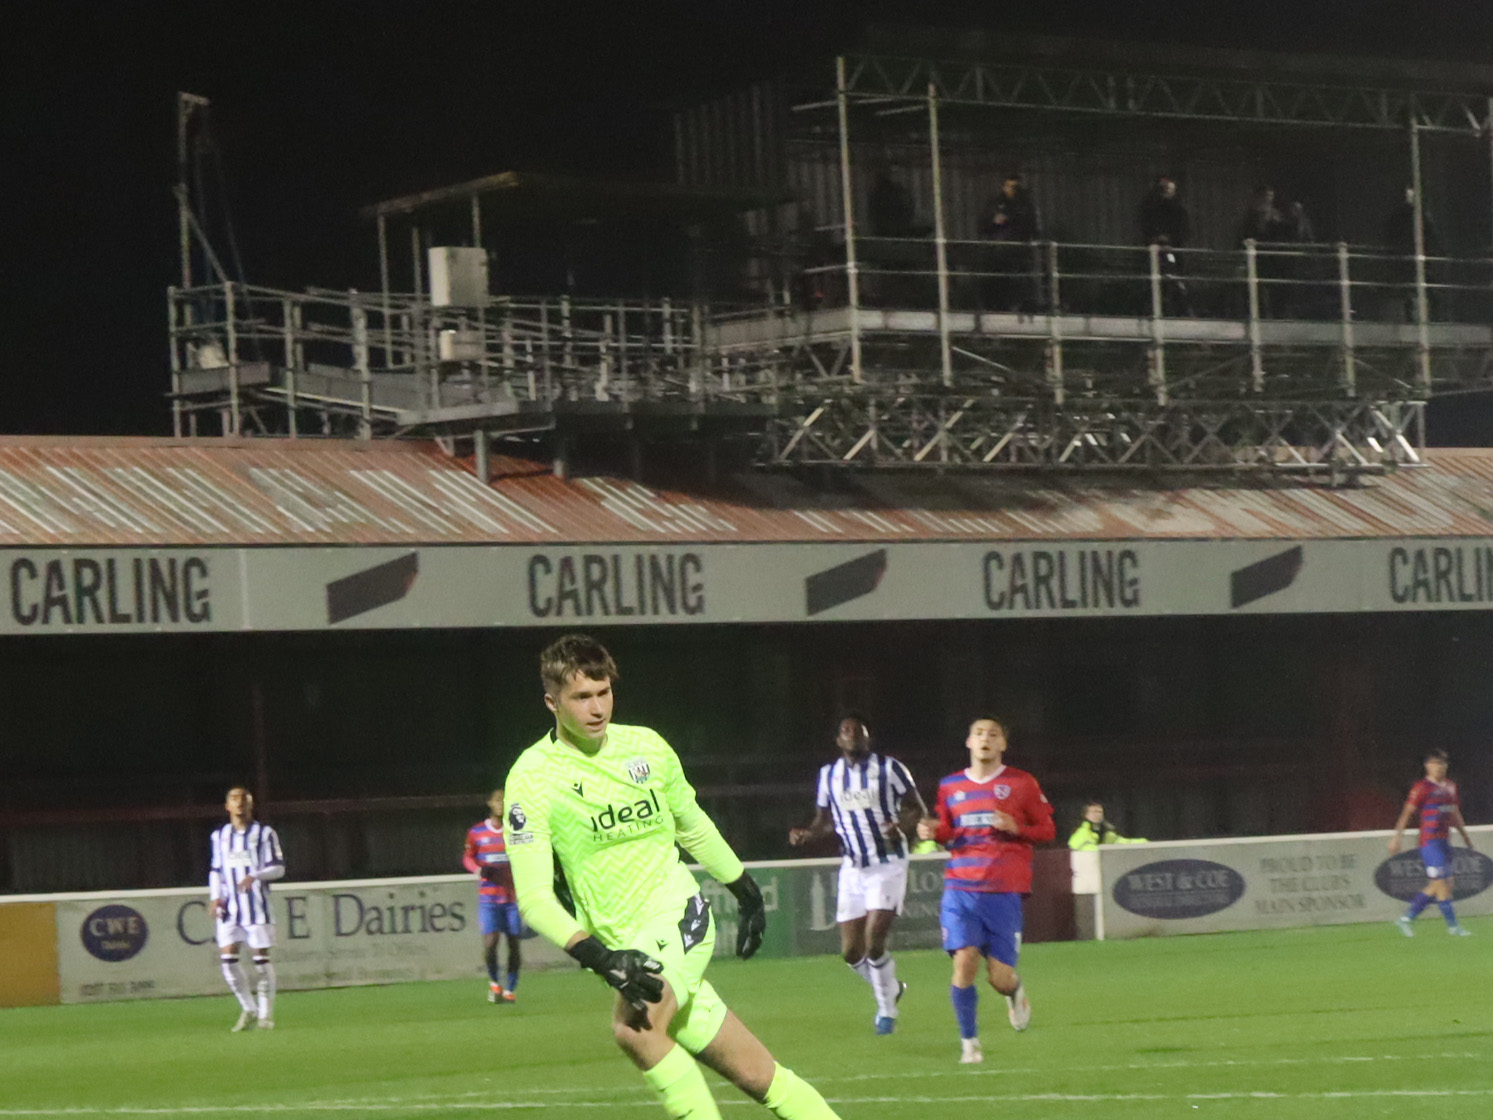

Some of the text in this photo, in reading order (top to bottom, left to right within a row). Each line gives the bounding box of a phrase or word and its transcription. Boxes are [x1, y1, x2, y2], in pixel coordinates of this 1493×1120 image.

[11, 557, 211, 626] CARLING
[528, 552, 705, 618] CARLING
[983, 549, 1140, 611] CARLING
[591, 788, 660, 832] ideal
[593, 816, 664, 842] HEATING
[1127, 869, 1232, 892] WEST & COE
[1259, 853, 1357, 874] PROUD TO BE
[1269, 877, 1299, 894] THE
[1298, 893, 1368, 913] SPONSOR
[331, 891, 467, 938] Dairies
